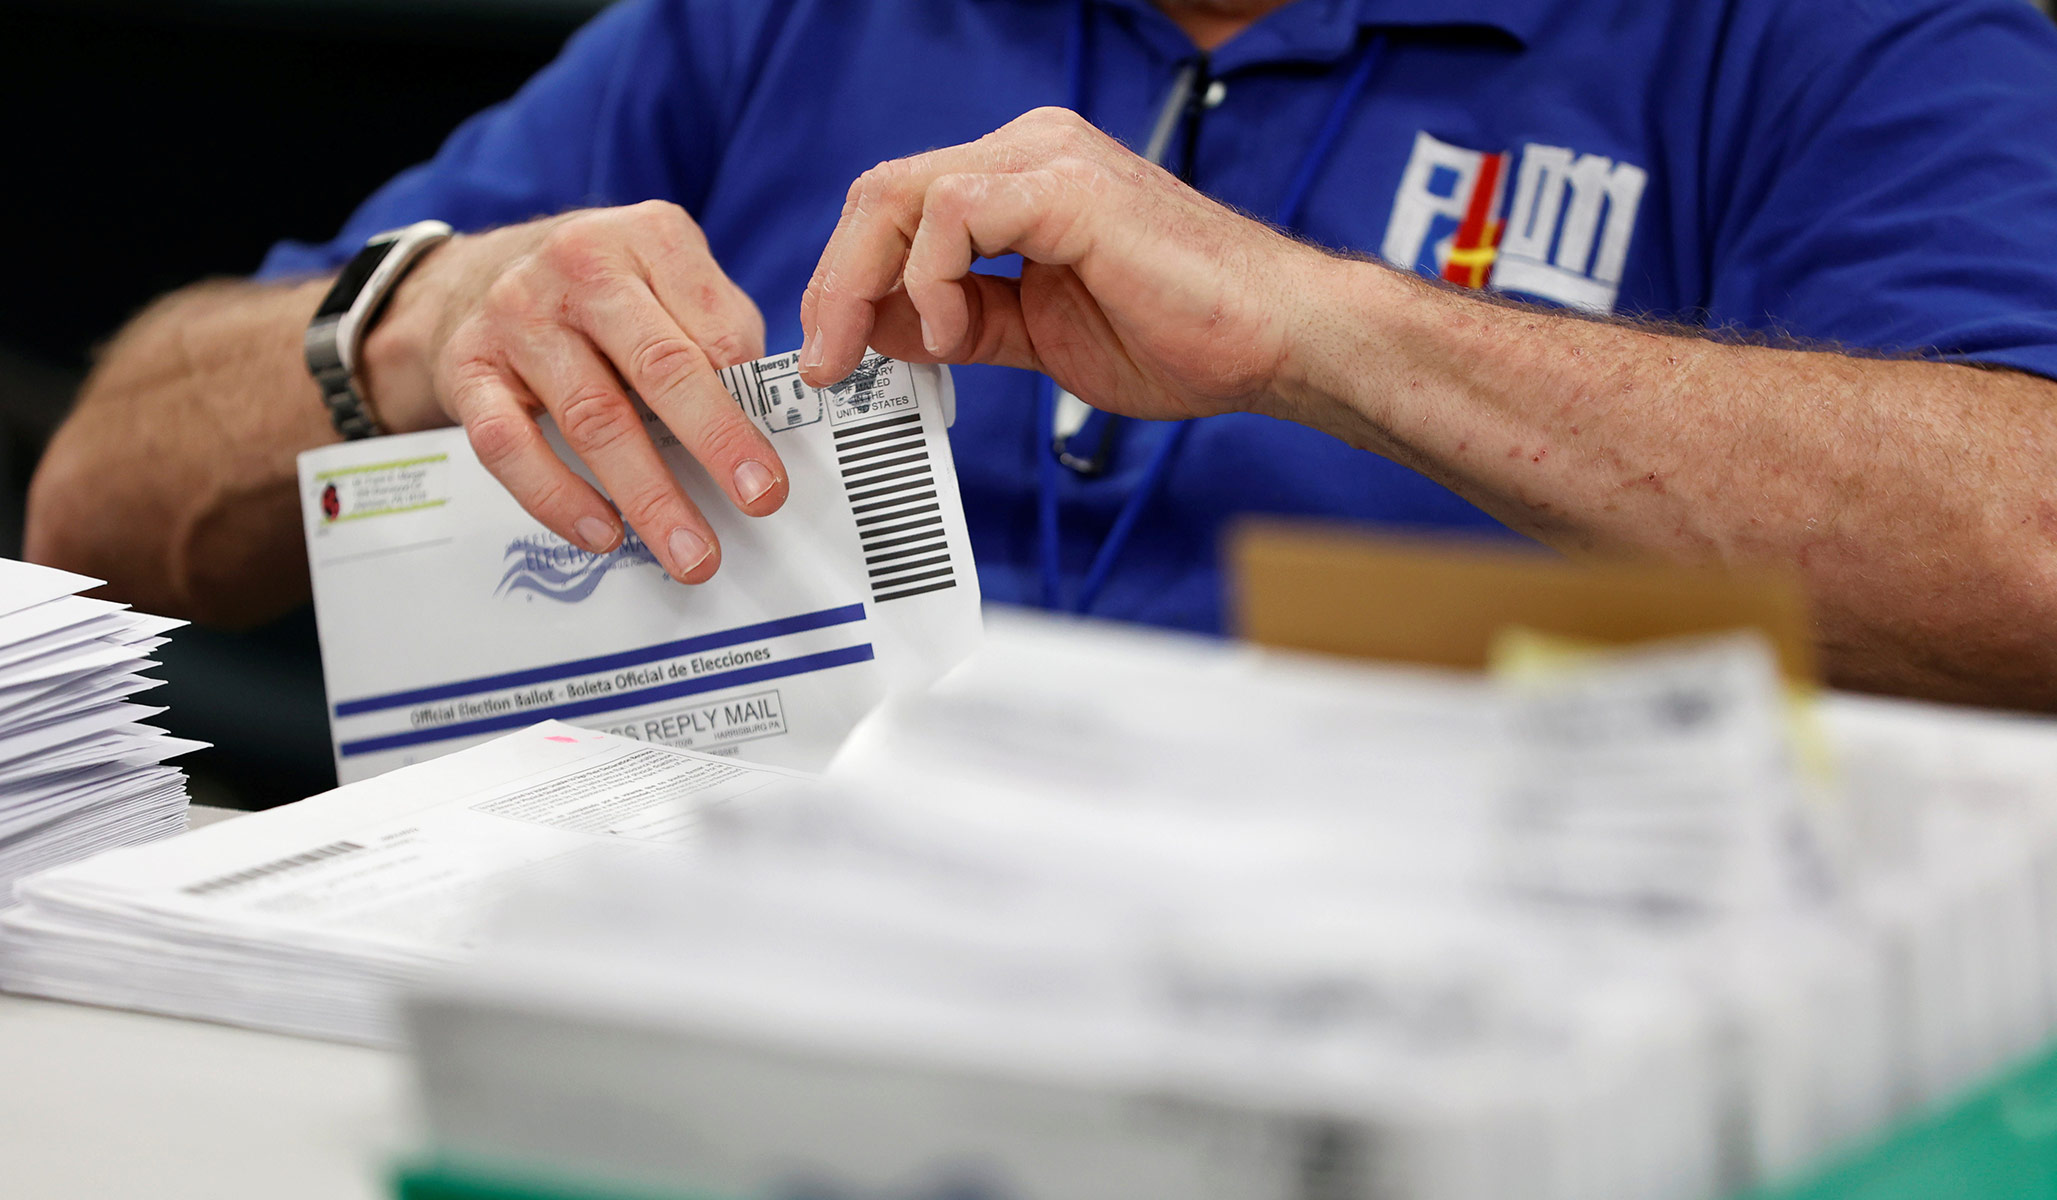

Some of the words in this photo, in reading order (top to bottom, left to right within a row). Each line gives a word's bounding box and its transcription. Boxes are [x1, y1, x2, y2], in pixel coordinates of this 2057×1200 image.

[754, 358, 789, 373] Energy
[865, 389, 885, 401] THE
[836, 404, 870, 419] UNITED
[872, 395, 909, 411] STATES
[410, 707, 455, 729] Official
[458, 699, 511, 717] Election
[514, 690, 555, 707] Ballot
[566, 680, 611, 697] Boleta
[615, 667, 663, 689] Oficial
[668, 664, 687, 679] de
[691, 647, 771, 674] Elecciones
[644, 709, 717, 742] REPLY
[725, 699, 777, 726] MAIL
[714, 723, 767, 740] HARRISBURG
[769, 722, 780, 730] PA
